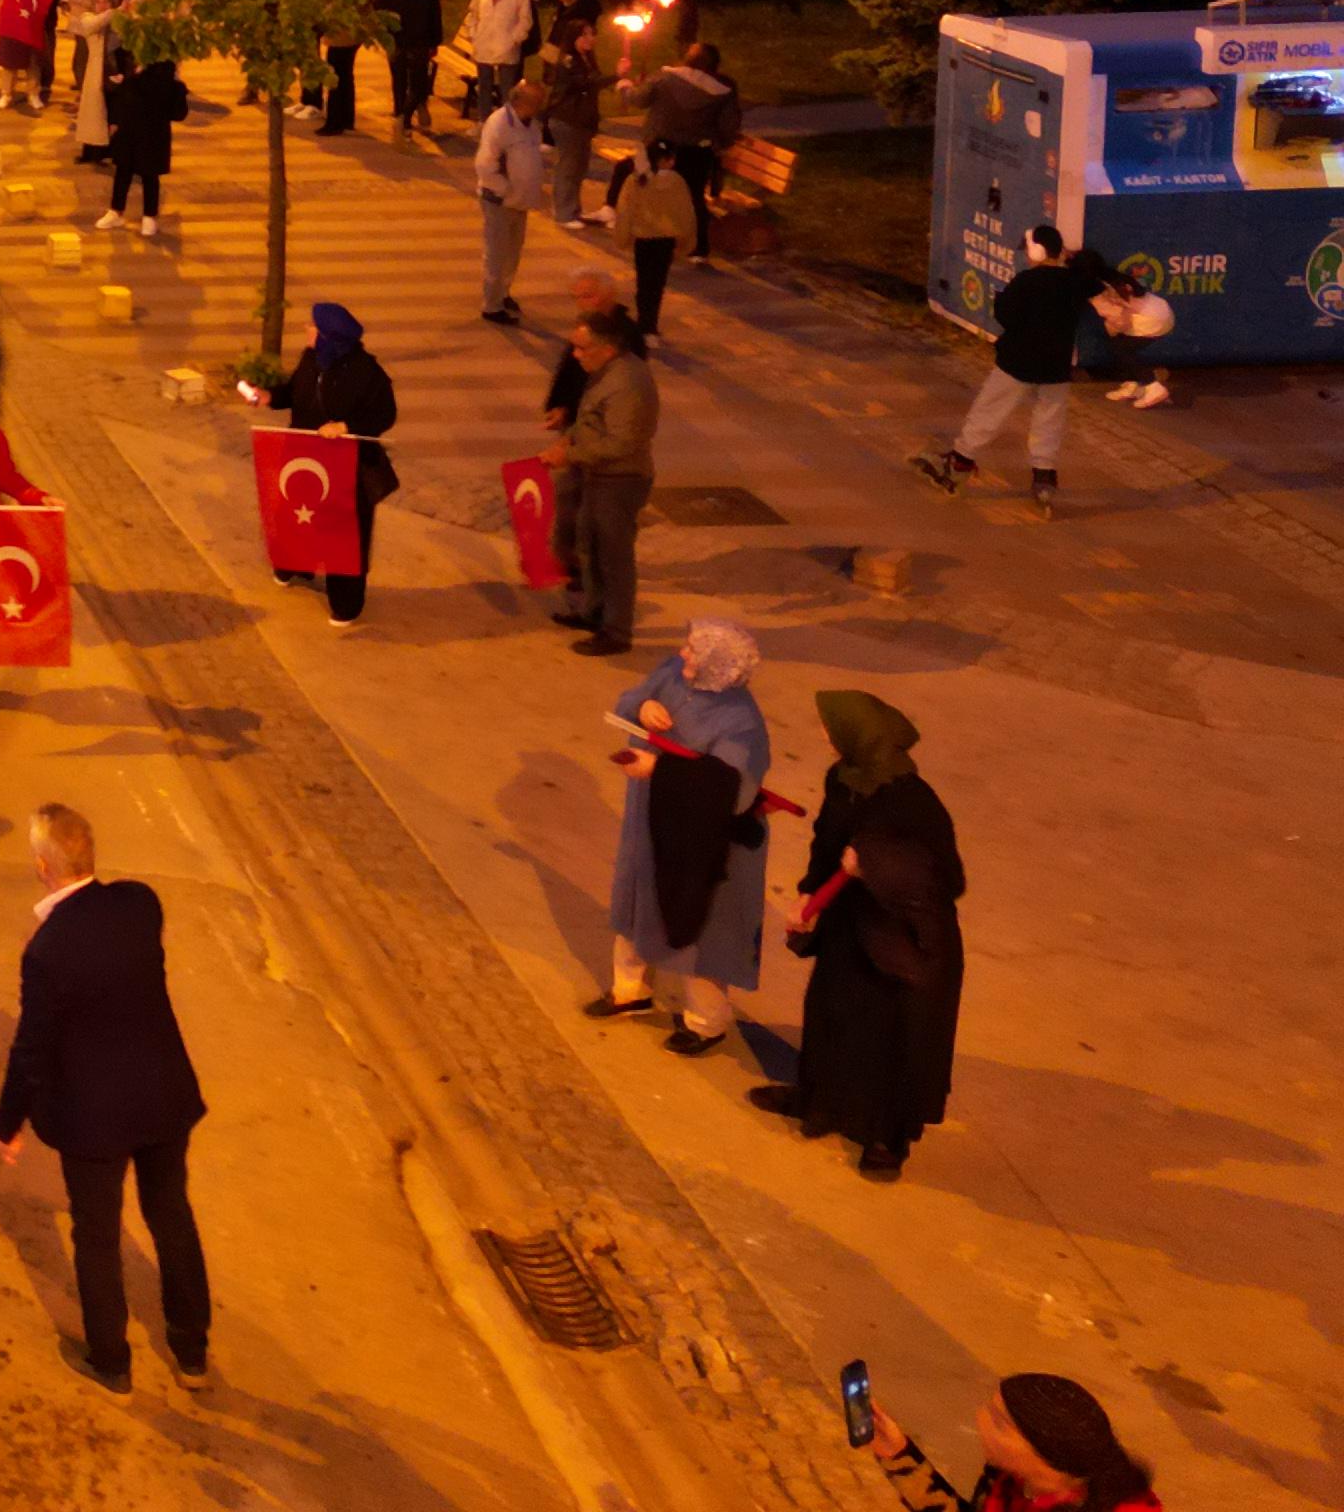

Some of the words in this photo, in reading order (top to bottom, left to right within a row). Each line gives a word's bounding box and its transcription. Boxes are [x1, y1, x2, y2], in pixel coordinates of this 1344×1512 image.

[1124, 173, 1162, 187] KAĞIT
[1173, 173, 1227, 185] KARTON
[1168, 253, 1227, 274] SIFIR
[1167, 274, 1225, 295] ATIK
